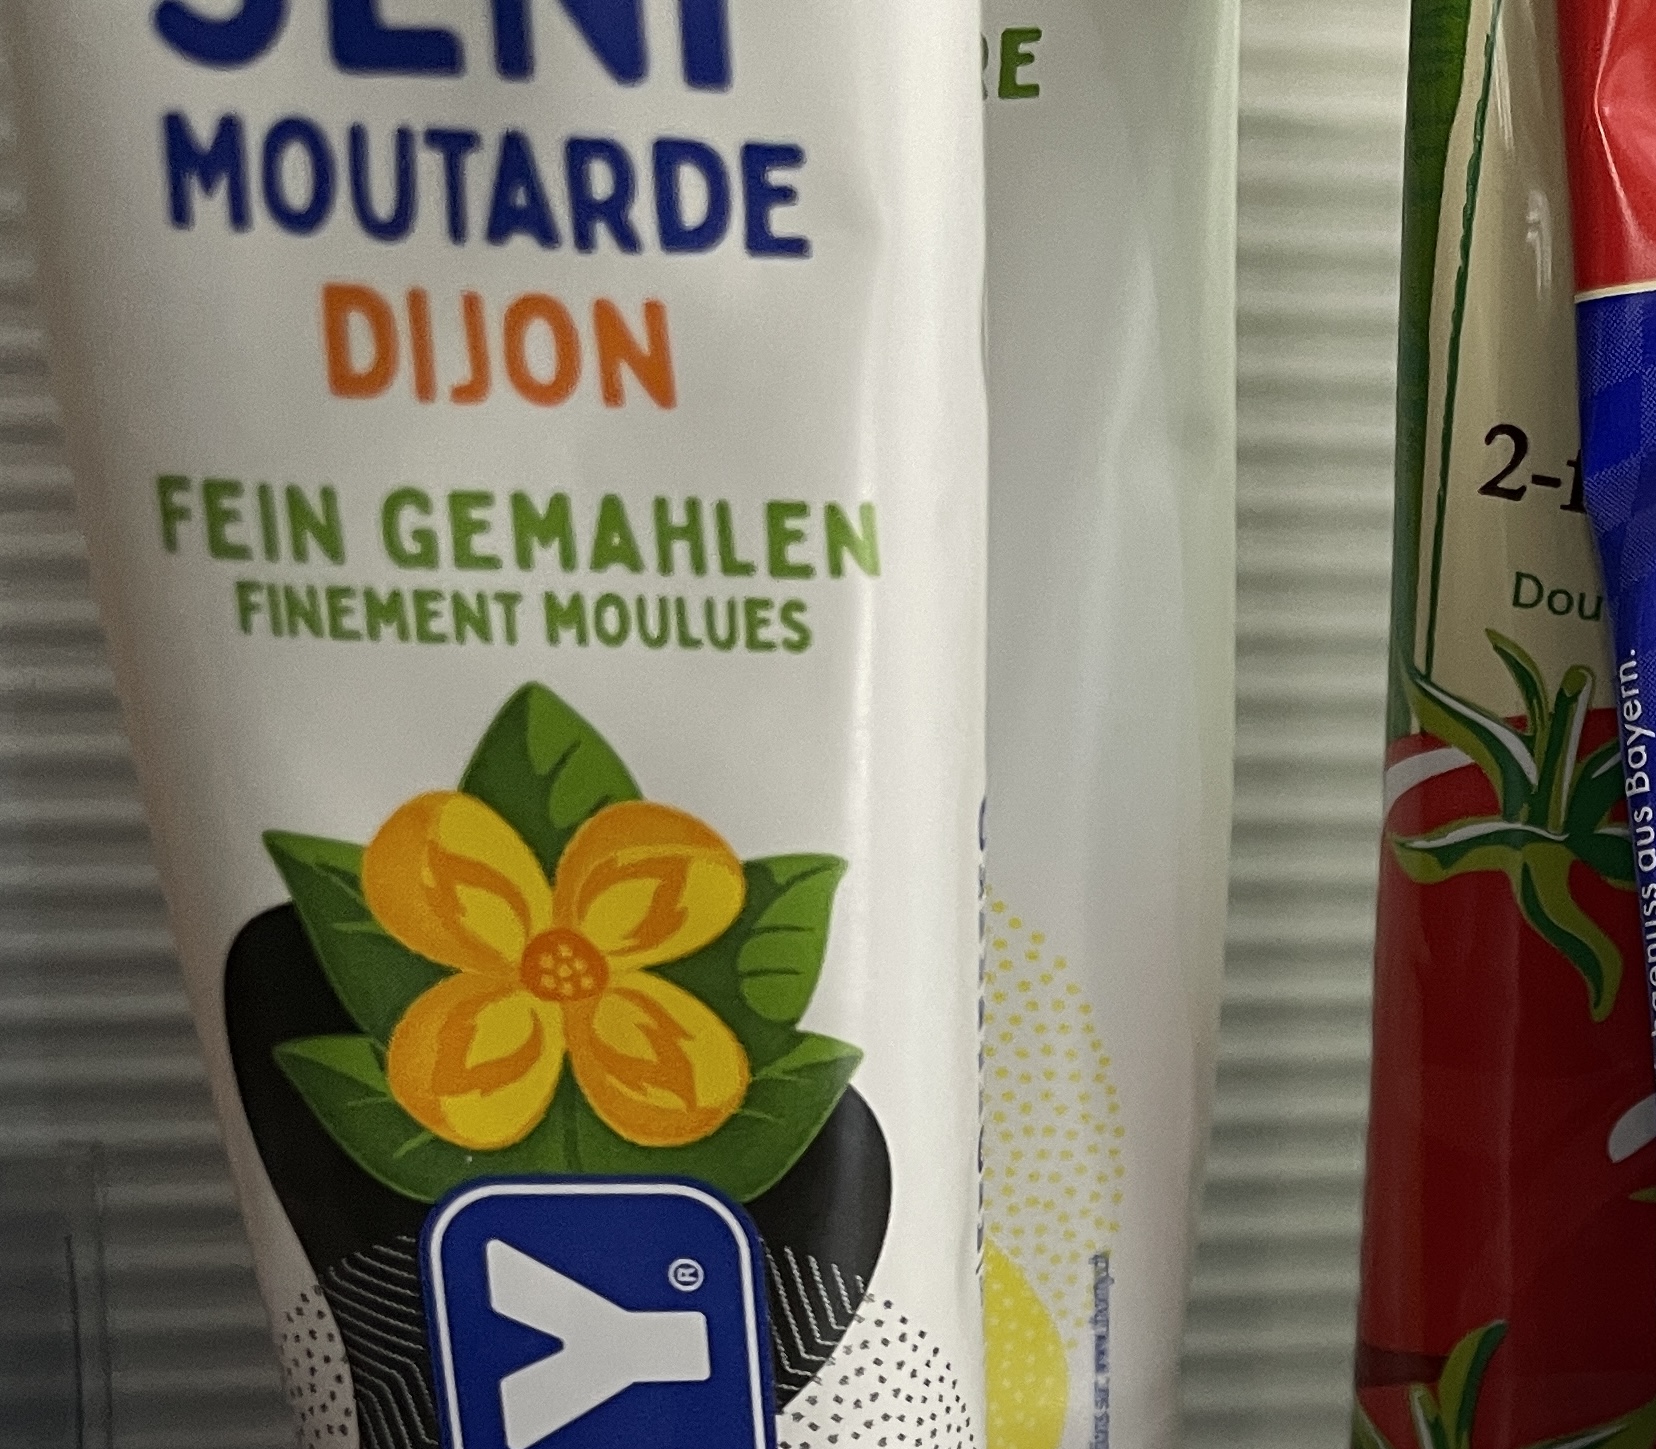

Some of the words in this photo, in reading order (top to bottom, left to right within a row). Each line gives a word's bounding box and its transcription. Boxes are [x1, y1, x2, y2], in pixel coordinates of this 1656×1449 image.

[163, 111, 812, 259] MOUTARDE
[321, 280, 678, 410] DIJON
[155, 474, 347, 567] FEIN
[380, 487, 881, 580] GEMAHLEN
[235, 580, 523, 645] FINEMENT
[545, 591, 814, 654] MOULUES
[1619, 649, 1656, 797] Bayern.
